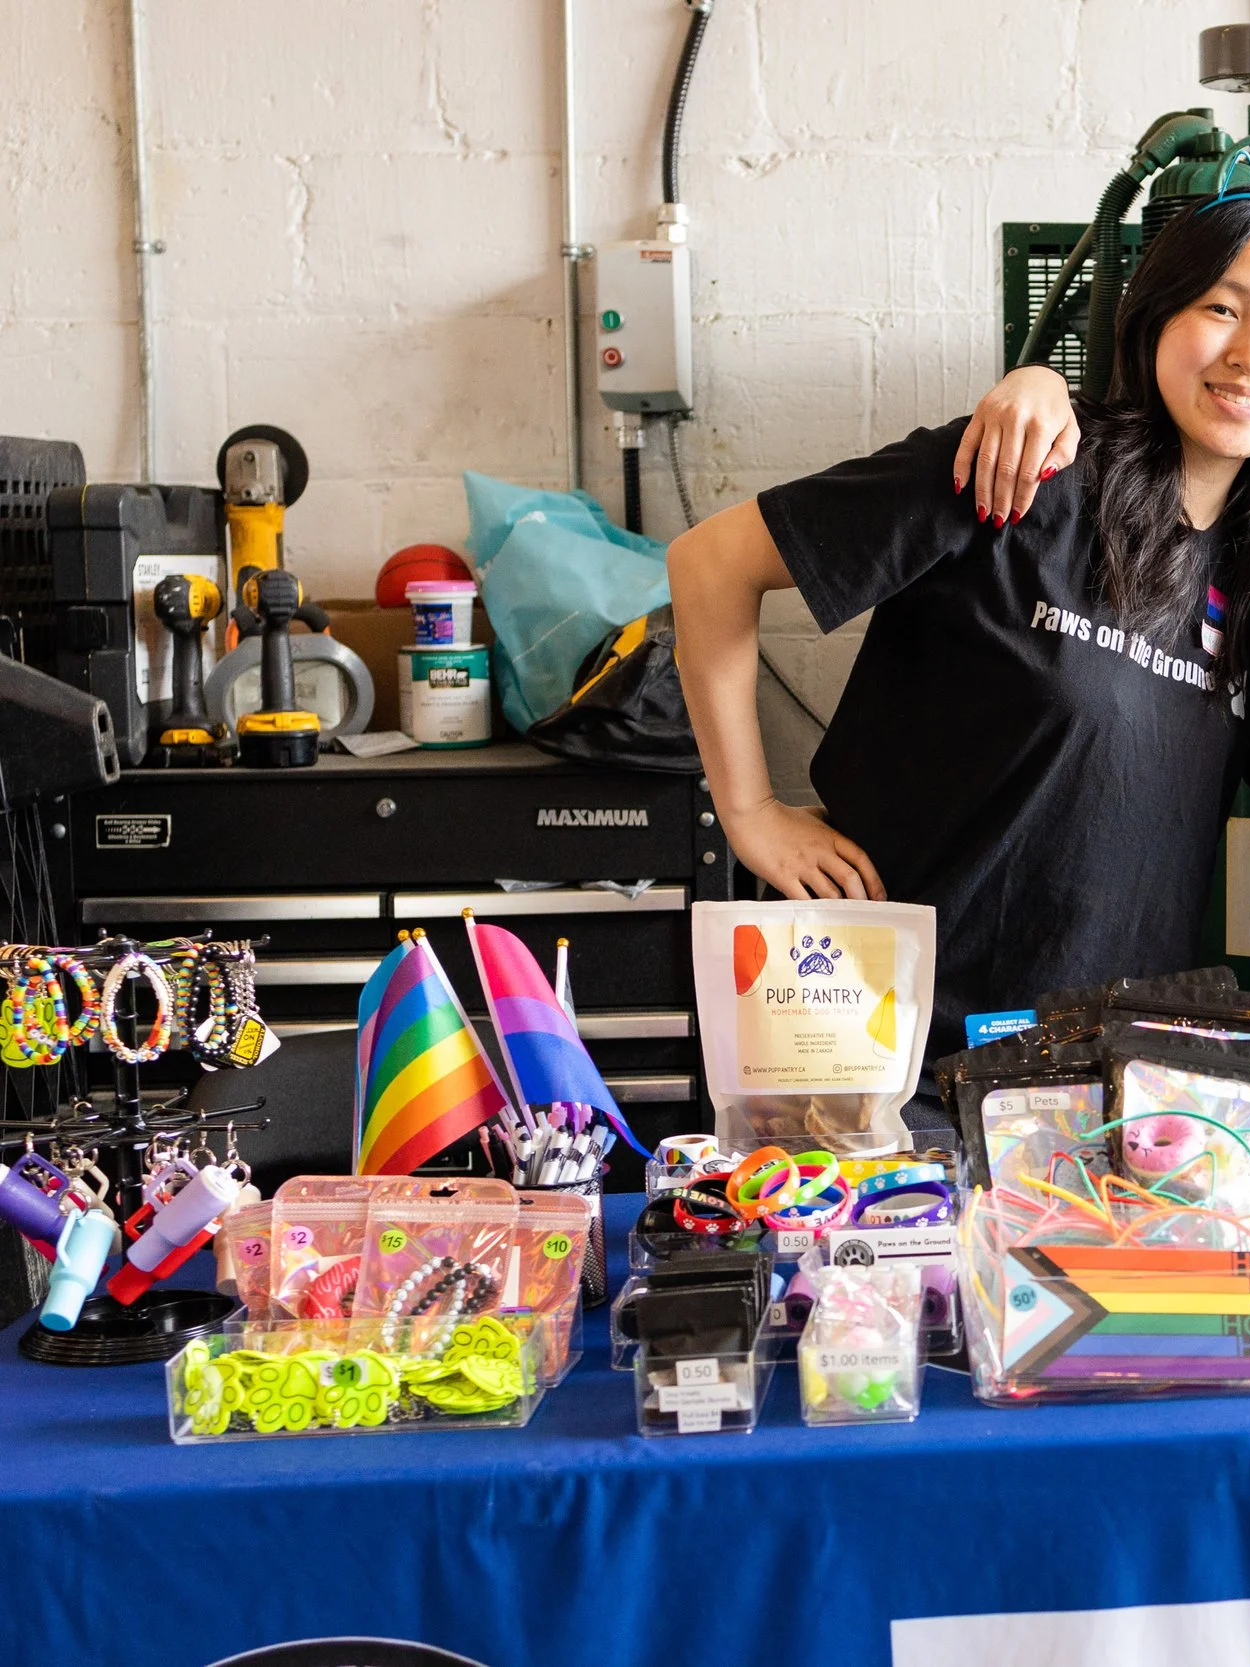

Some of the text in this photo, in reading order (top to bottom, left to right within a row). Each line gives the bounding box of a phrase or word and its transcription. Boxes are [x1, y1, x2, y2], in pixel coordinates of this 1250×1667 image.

[1030, 600, 1092, 641] Paws
[1096, 625, 1125, 654] on
[1128, 632, 1152, 669] the
[429, 668, 457, 681] BEHR
[537, 808, 649, 826] MAXIMUM
[766, 988, 863, 1004] PUP PANTRY
[771, 1008, 812, 1016] HOMEMADE
[978, 1025, 988, 1034] 4
[999, 1101, 1014, 1112] $5
[1034, 1096, 1059, 1106] Pets
[672, 1188, 725, 1208] LOVE IS
[291, 1231, 307, 1245] $2
[381, 1234, 403, 1248] $15
[782, 1236, 809, 1247] 0.50
[923, 1238, 952, 1246] Ground
[246, 1243, 264, 1257] $2
[546, 1240, 568, 1253] $10
[819, 1352, 899, 1368] $1.00 items
[338, 1364, 355, 1381] $1
[682, 1365, 713, 1380] 0.50
